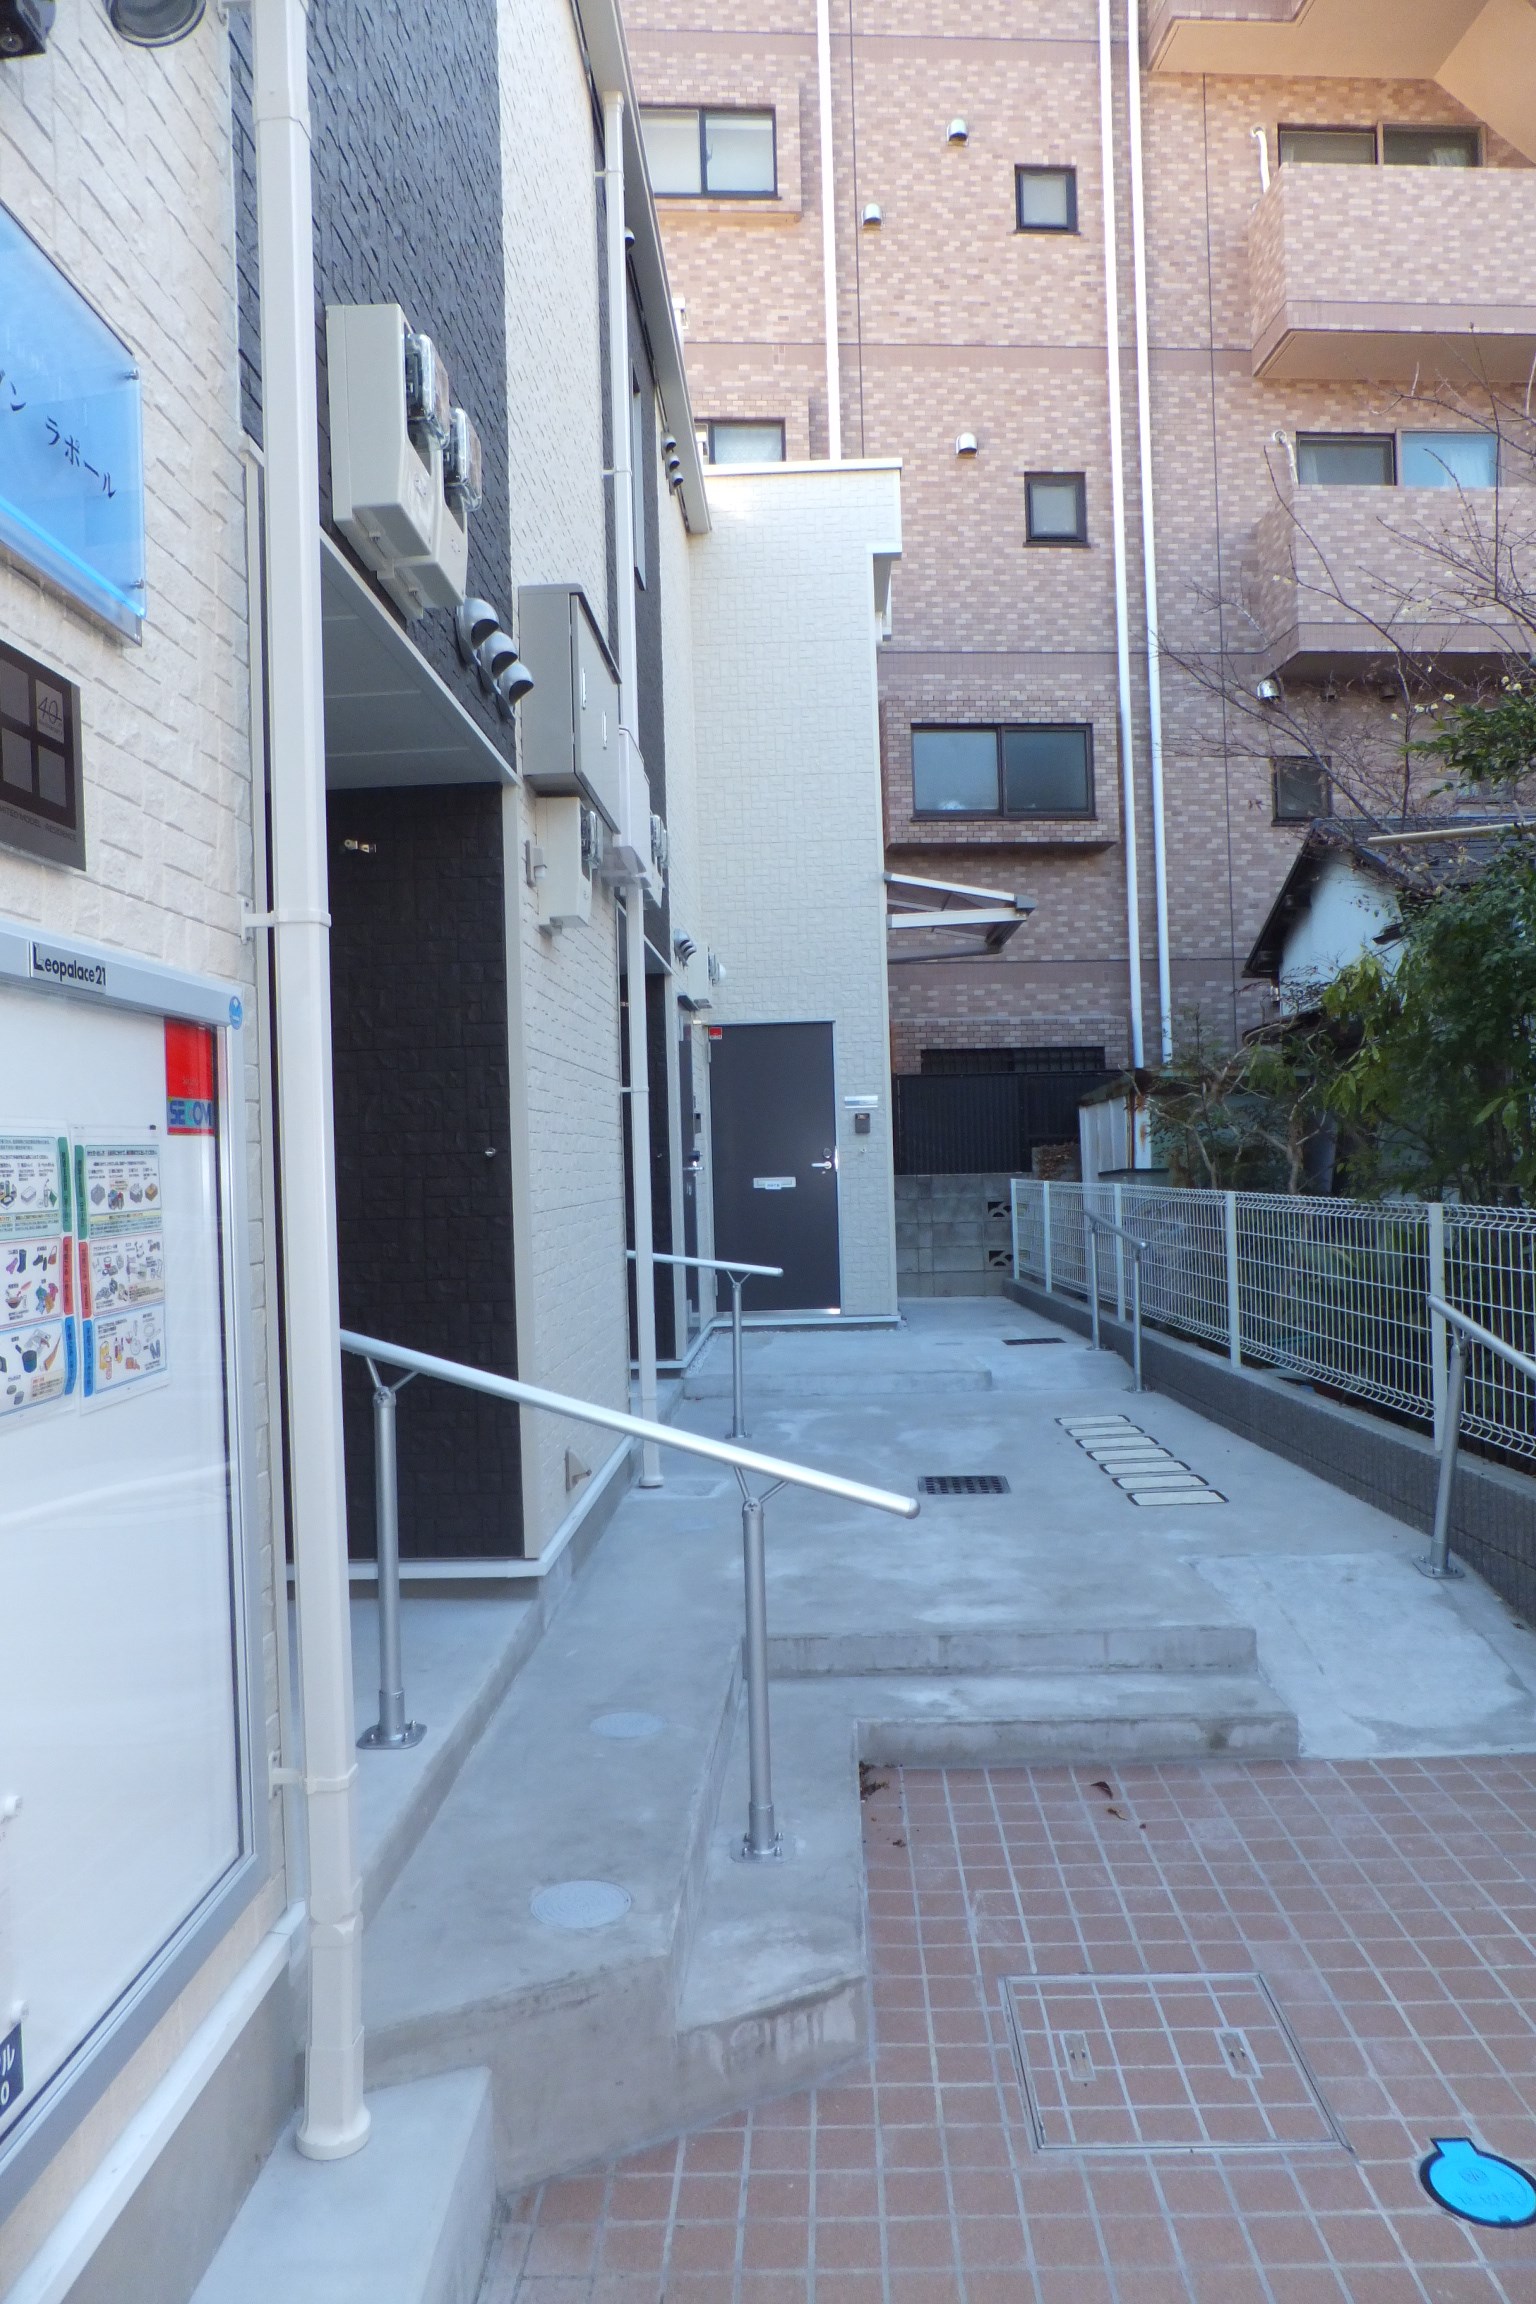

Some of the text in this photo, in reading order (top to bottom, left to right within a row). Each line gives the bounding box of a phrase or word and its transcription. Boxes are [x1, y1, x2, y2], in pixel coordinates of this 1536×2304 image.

[45, 416, 116, 499] ラポール
[32, 941, 106, 986] Leopalace21
